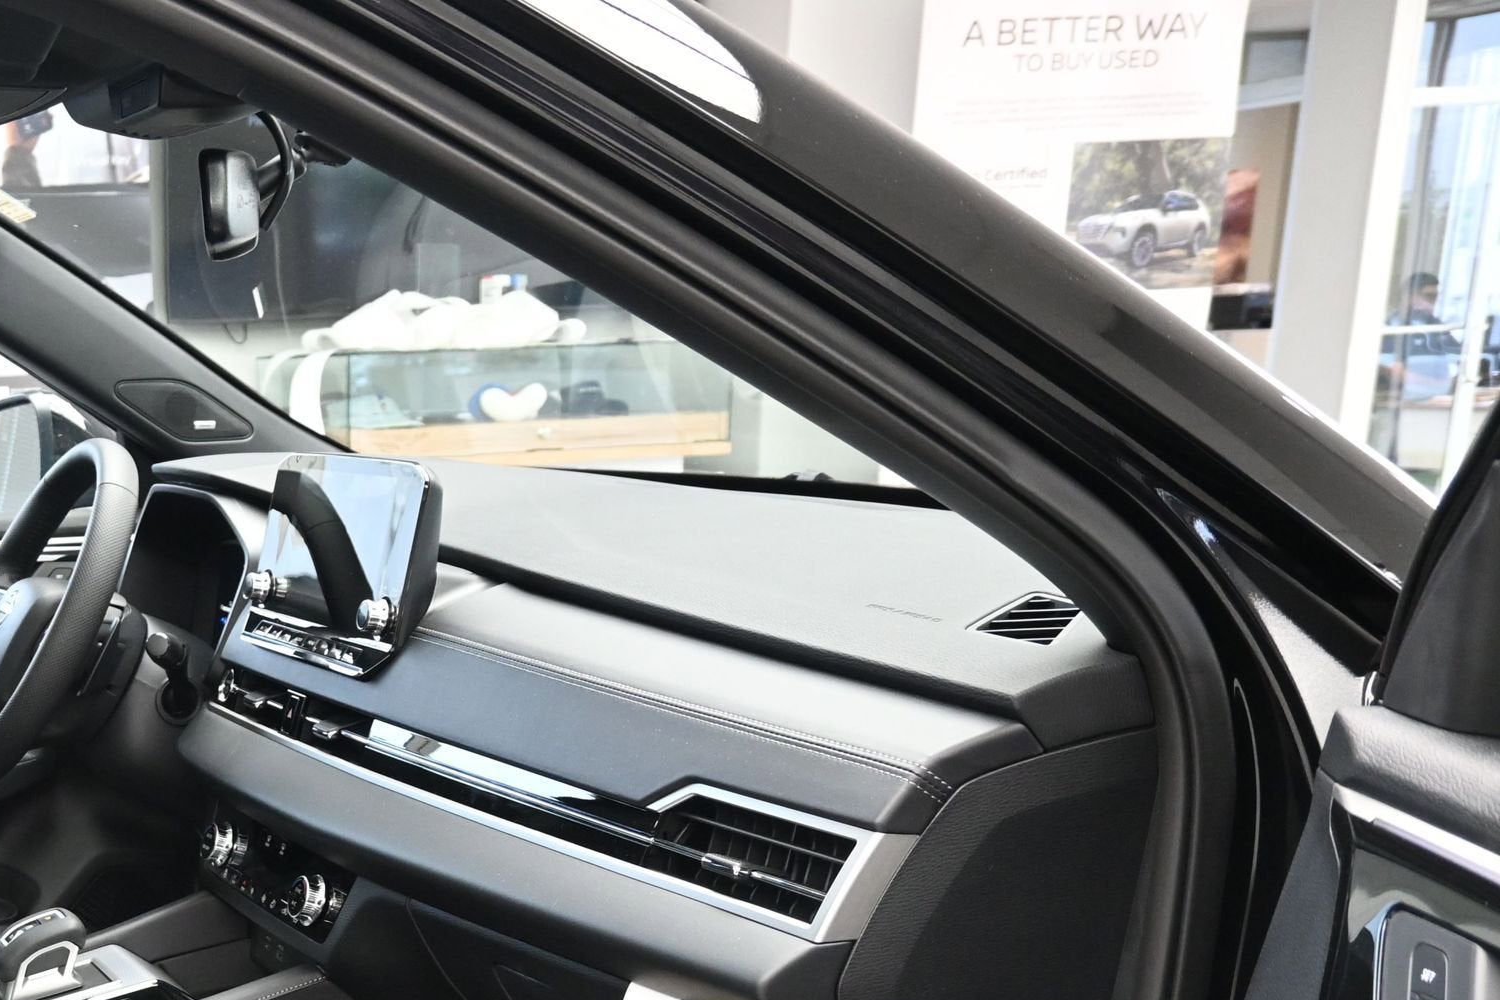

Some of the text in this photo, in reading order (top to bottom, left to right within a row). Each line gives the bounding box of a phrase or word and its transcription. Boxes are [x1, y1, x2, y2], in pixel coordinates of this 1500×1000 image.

[963, 12, 1208, 48] A BETTER WAY
[1014, 49, 1160, 73] TO BUY USED
[985, 166, 1049, 182] Certified
